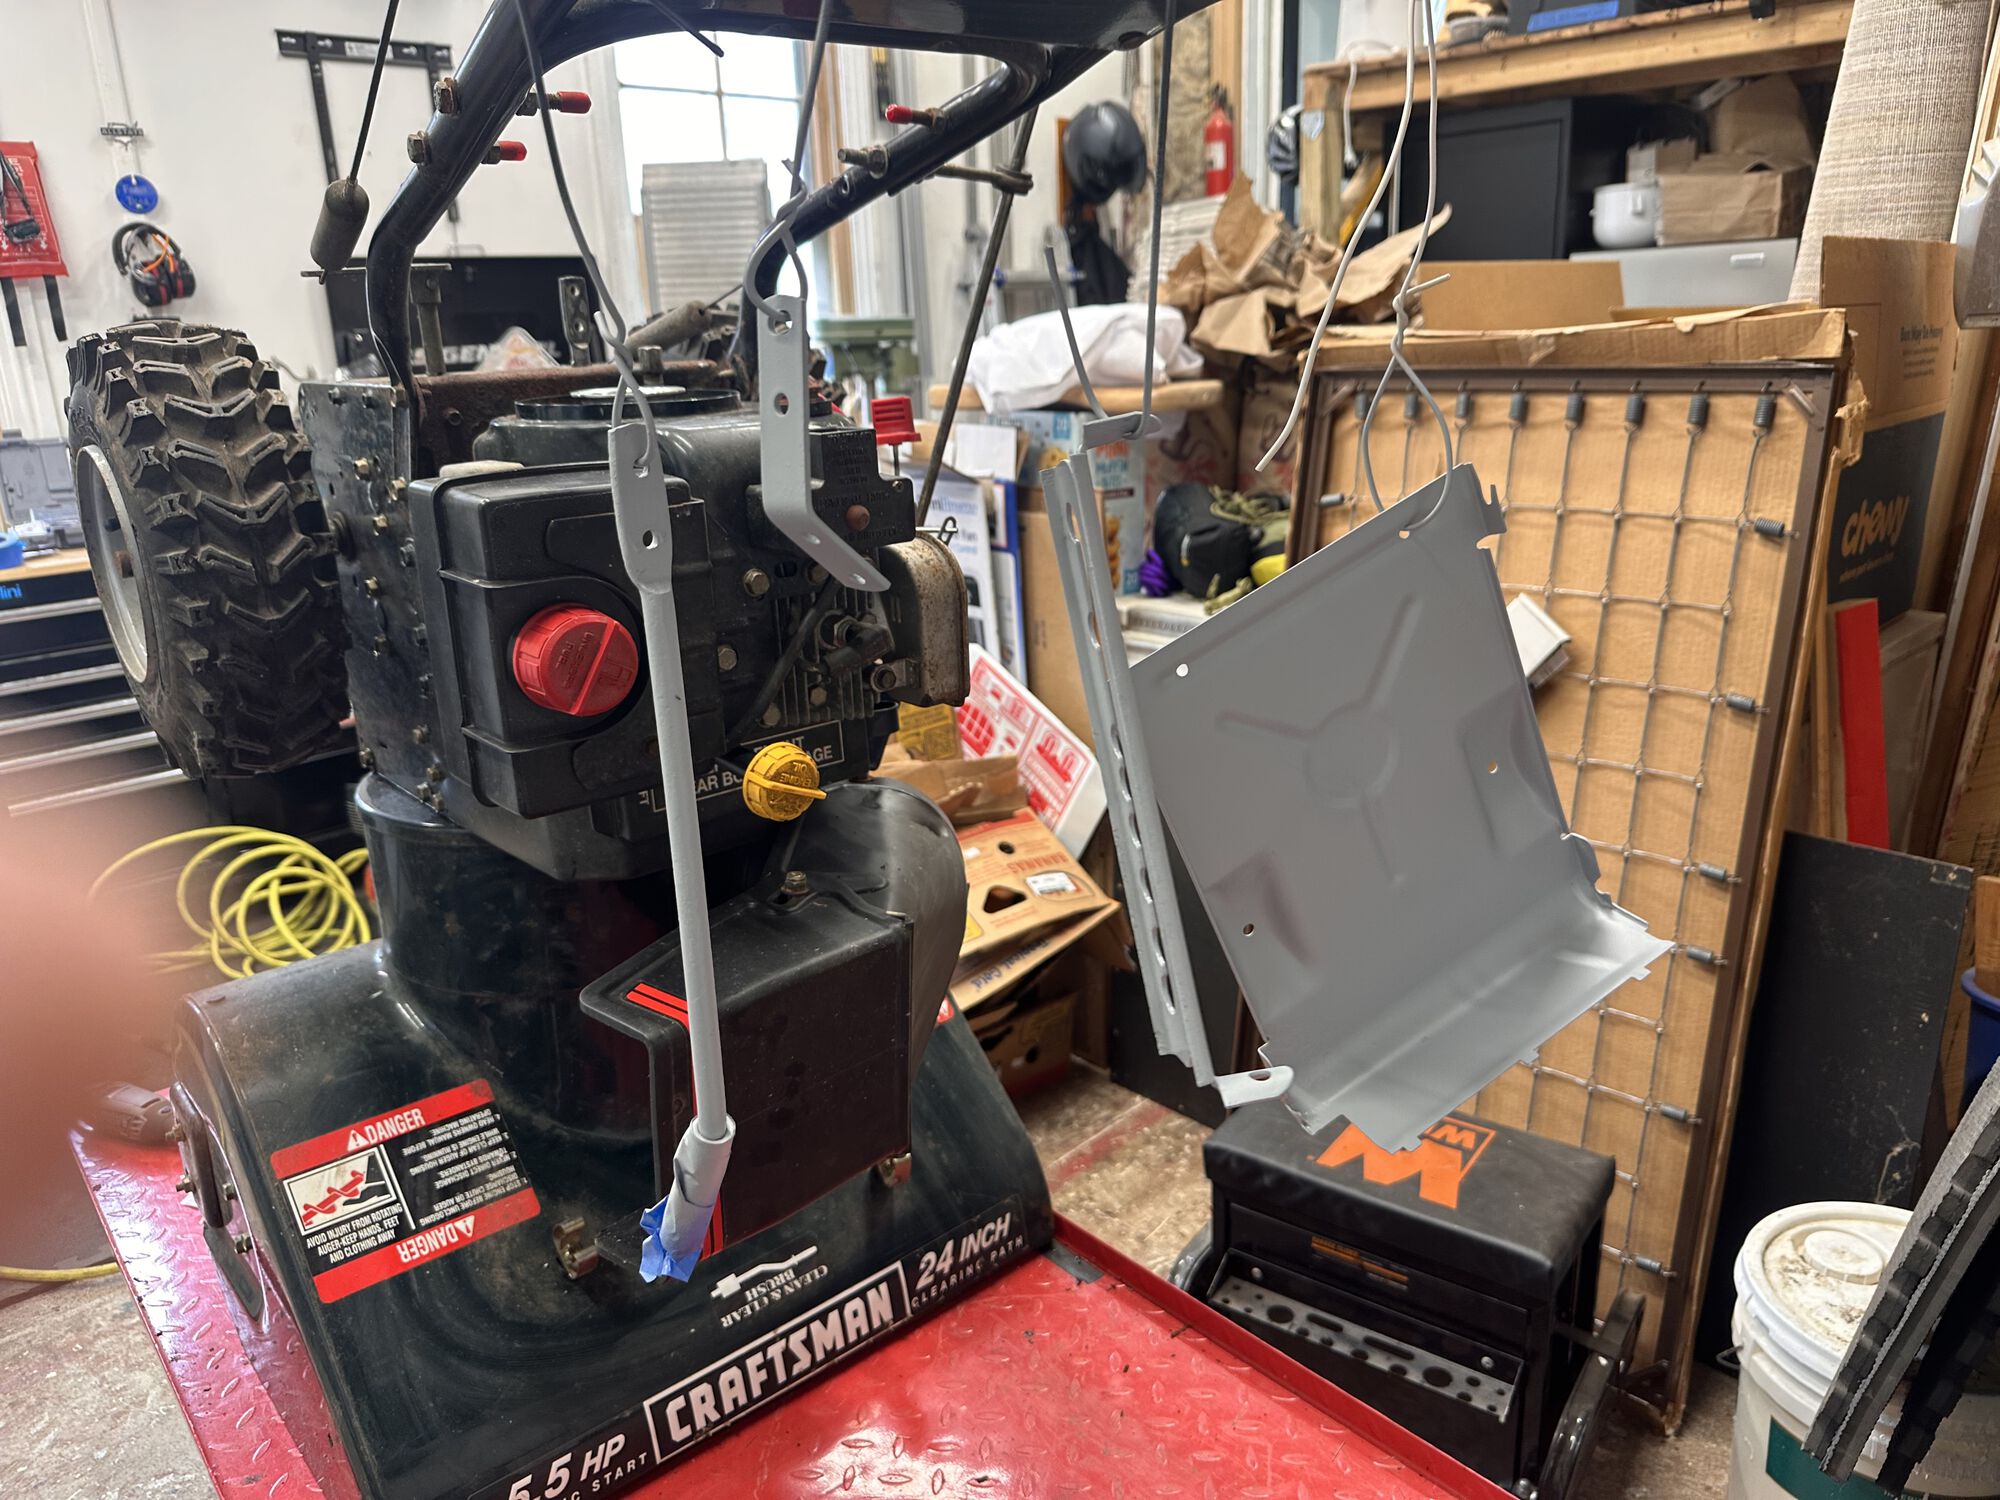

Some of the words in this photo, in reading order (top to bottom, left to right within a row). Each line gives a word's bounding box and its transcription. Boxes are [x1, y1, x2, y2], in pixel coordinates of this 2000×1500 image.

[1841, 496, 1910, 558] chewy
[1007, 851, 1069, 875] BANANAS
[364, 1108, 426, 1145] DANGER
[402, 1140, 427, 1156] BEFORE
[426, 1131, 453, 1147] MANUAL
[450, 1142, 459, 1151] IS
[467, 1140, 488, 1153] CLEAR
[487, 1135, 503, 1146] KEEP
[438, 1151, 459, 1165] AUGER
[459, 1147, 468, 1157] OF
[409, 1159, 439, 1177] HOUSING
[434, 1169, 470, 1189] DISCHARGE
[505, 1179, 522, 1192] STOP
[454, 1193, 465, 1202] OR
[464, 1185, 485, 1199] CHUTE
[483, 1186, 506, 1200] ENGINE
[433, 1197, 455, 1212] AUGER
[460, 1195, 484, 1210] BEFORE
[383, 1215, 400, 1230] FEET
[419, 1204, 461, 1227] UNCLOGGING
[306, 1232, 327, 1249] AVOID
[327, 1222, 352, 1241] INJURY
[351, 1215, 372, 1231] FROM
[371, 1202, 403, 1225] ROTATING
[329, 1249, 345, 1264] AND
[344, 1237, 378, 1258] CLOTHING
[377, 1229, 396, 1244] AWAY
[395, 1221, 459, 1263] DANGER
[915, 1239, 955, 1290] 24
[959, 1211, 1011, 1263] INCH
[783, 1264, 828, 1296] CLEAN
[911, 1258, 984, 1308] CLEARING
[990, 1234, 1023, 1262] PATH
[745, 1267, 796, 1301] BRUSH
[769, 1288, 782, 1301] &
[720, 1296, 769, 1328] CLEAR
[665, 1281, 894, 1443] CRAFTSMAN
[580, 1433, 626, 1481] HP
[591, 1452, 648, 1492] START
